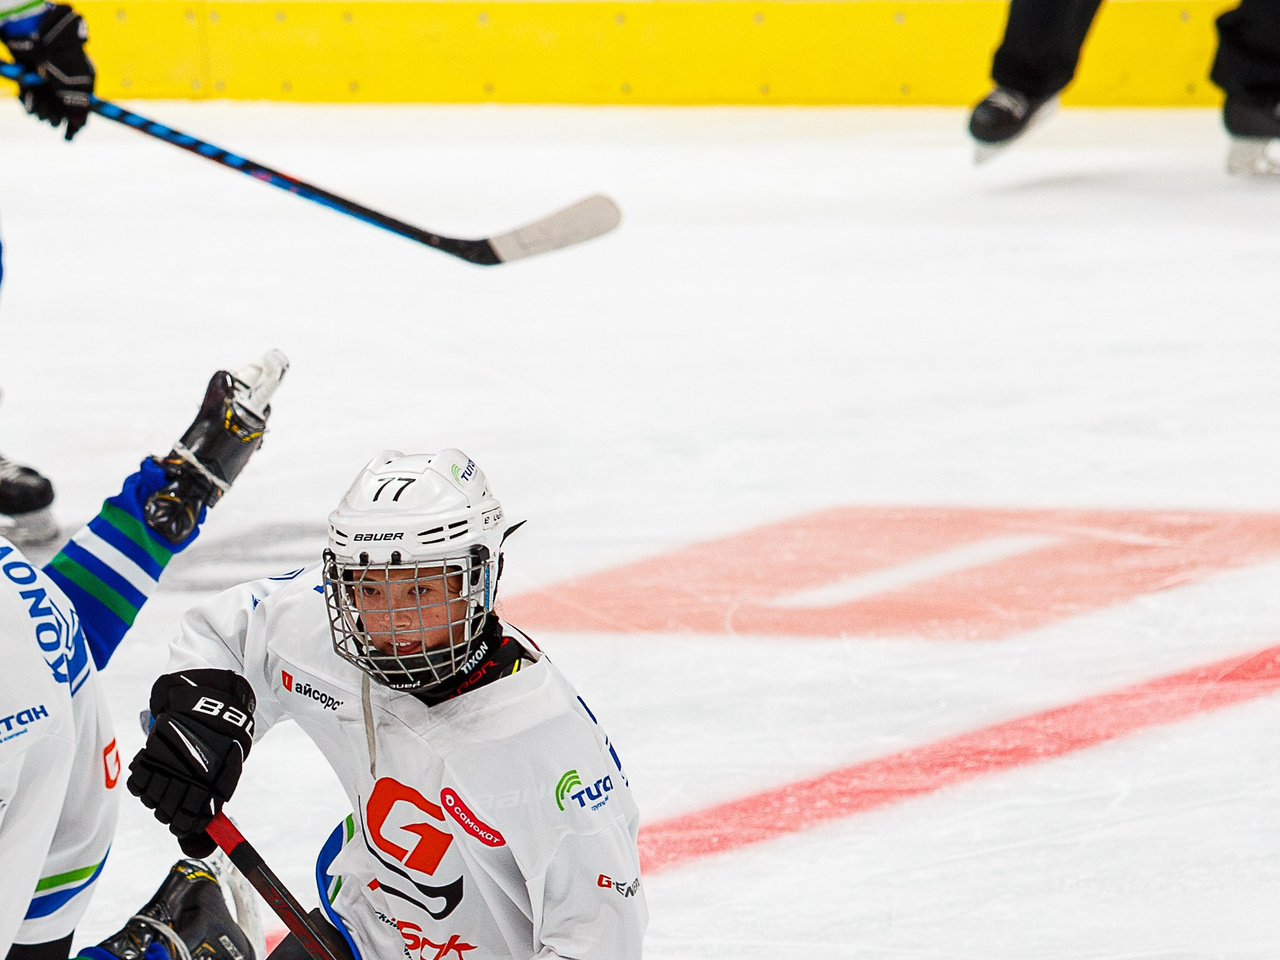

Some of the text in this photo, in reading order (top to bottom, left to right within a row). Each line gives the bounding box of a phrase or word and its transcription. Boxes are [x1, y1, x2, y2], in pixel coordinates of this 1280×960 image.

[372, 477, 417, 502] 77
[353, 532, 405, 542] BAUER
[460, 641, 489, 675] TIXON
